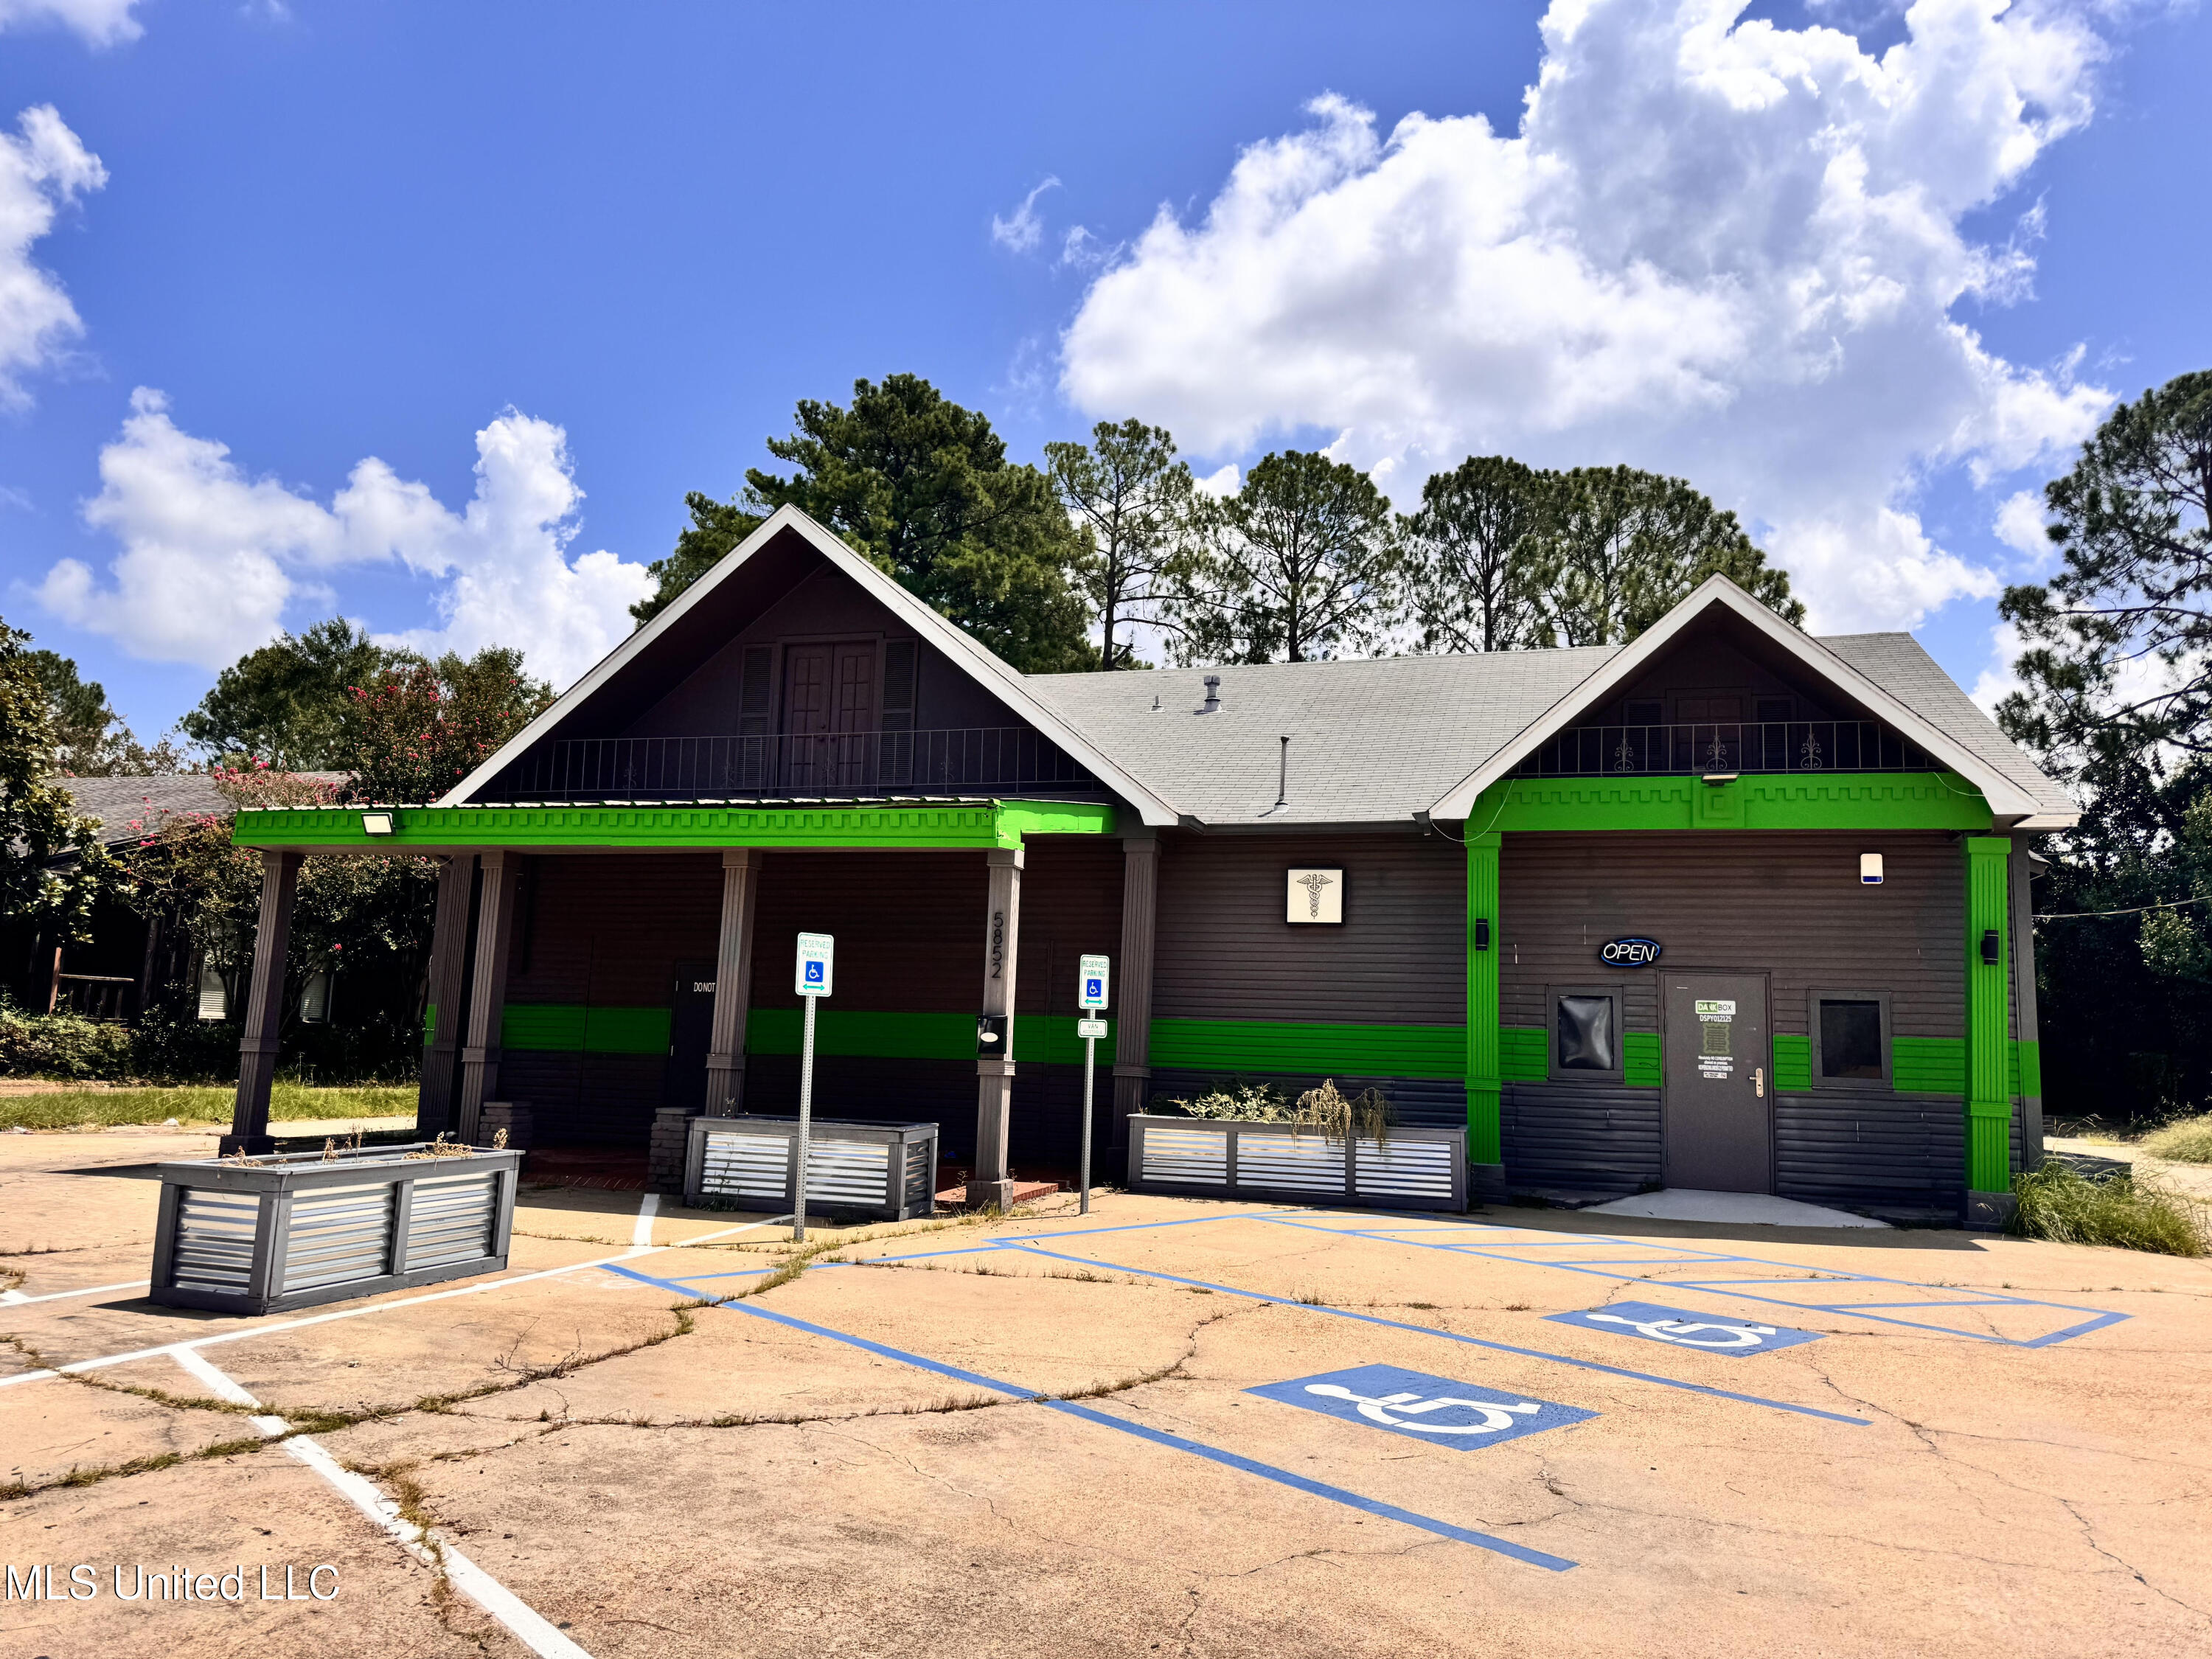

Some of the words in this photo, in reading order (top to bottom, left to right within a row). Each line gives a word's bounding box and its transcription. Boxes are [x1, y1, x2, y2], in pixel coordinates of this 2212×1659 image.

[800, 939, 830, 949] RESERVED
[992, 912, 1004, 978] 5852
[801, 950, 828, 959] PARKING
[1603, 943, 1655, 961] OPEN
[1082, 960, 1107, 968] RESERVED
[1084, 969, 1105, 977] PARKING
[693, 981, 703, 992] DO
[703, 981, 716, 992] NOT
